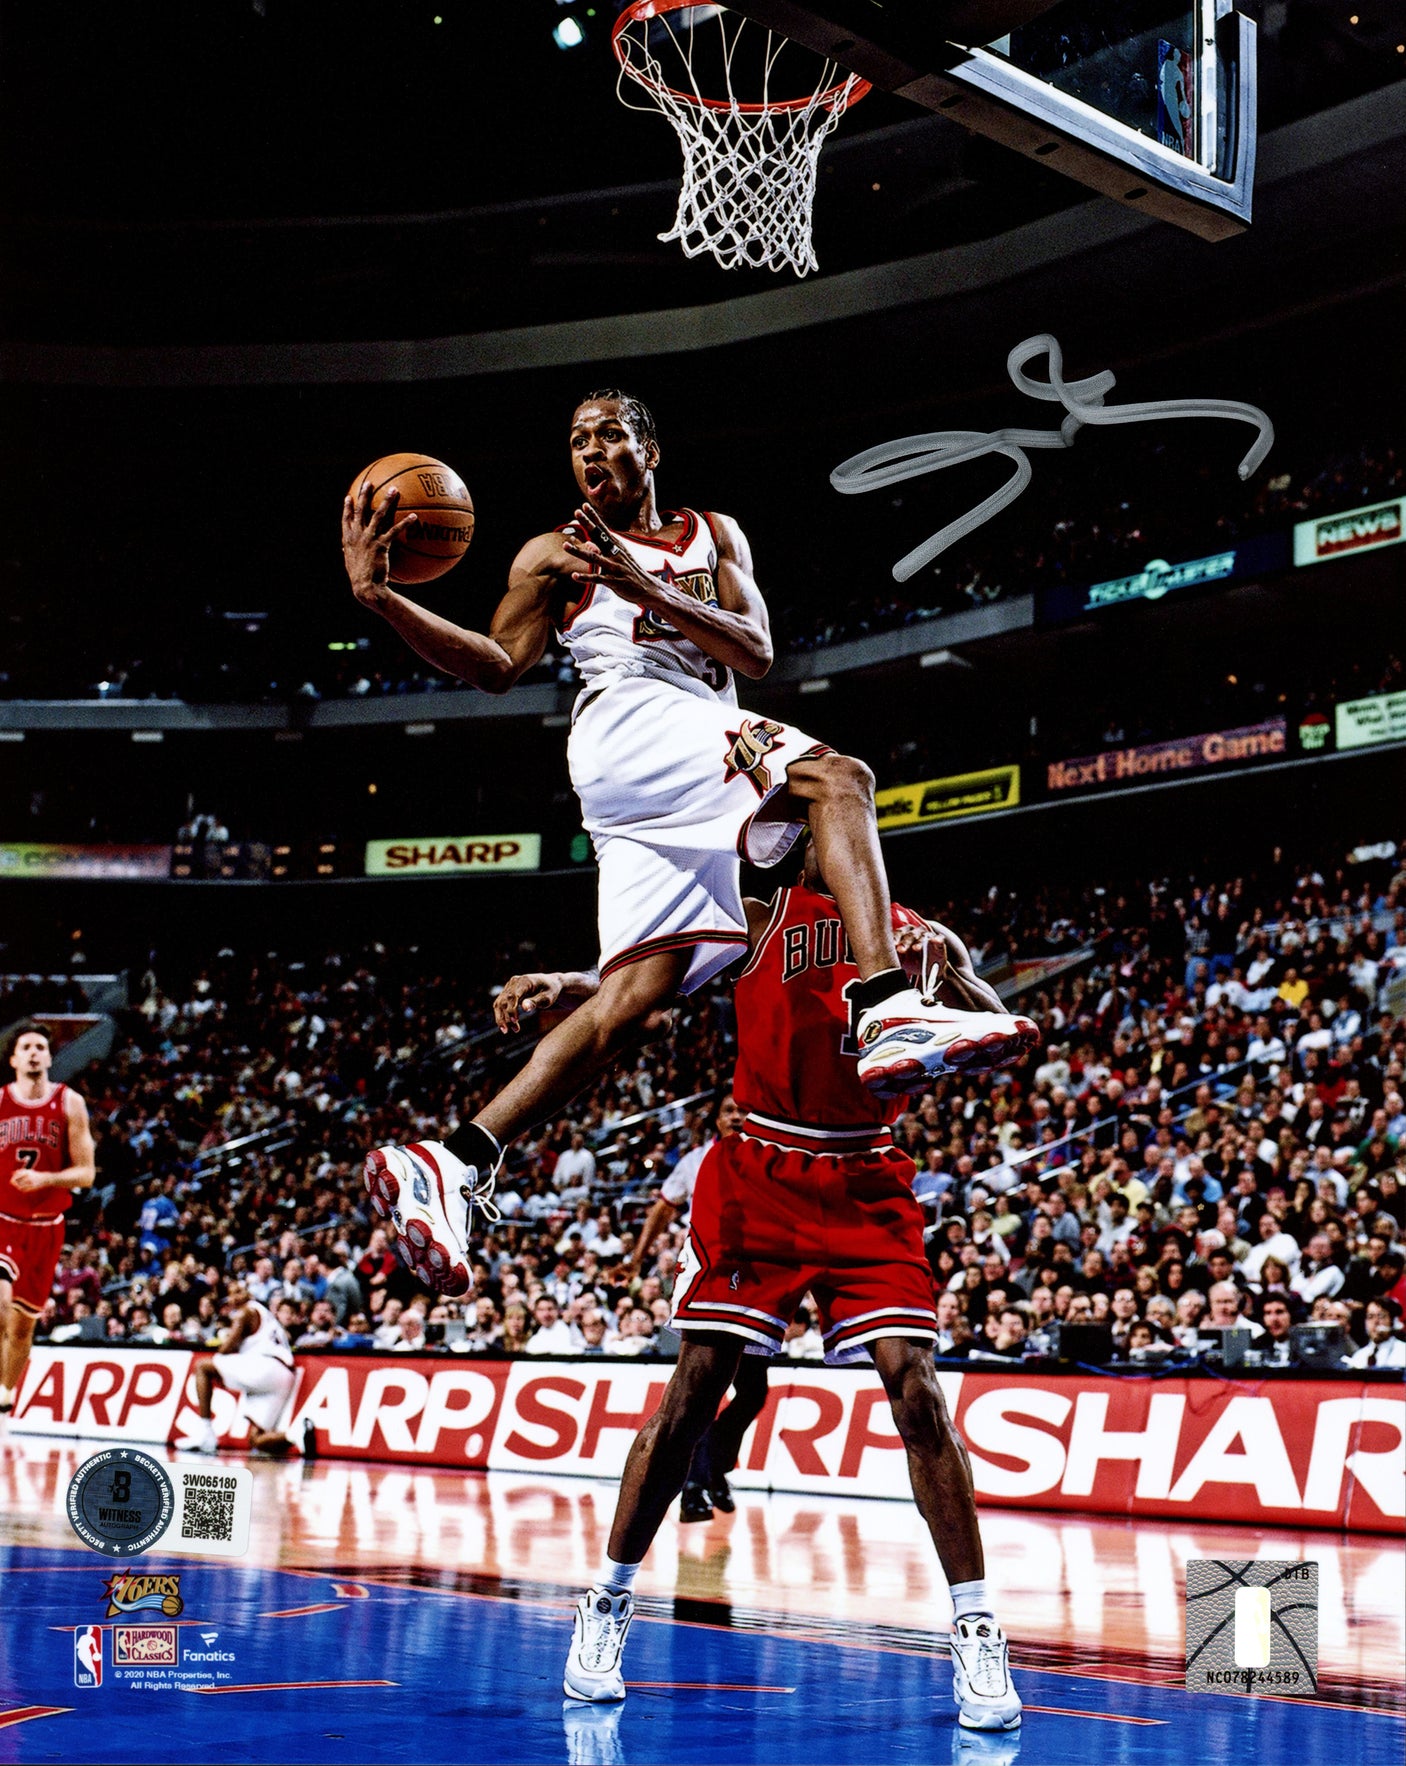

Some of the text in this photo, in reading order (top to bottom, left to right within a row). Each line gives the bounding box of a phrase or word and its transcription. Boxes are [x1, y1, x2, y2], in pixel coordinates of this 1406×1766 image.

[1319, 510, 1398, 547] NEWS
[1048, 754, 1107, 789] Next
[1114, 748, 1194, 778] Home
[1202, 731, 1286, 763] Game
[385, 841, 520, 869] SHARP
[16, 1147, 41, 1170] 7
[503, 1376, 905, 1478] SHRP
[183, 1474, 237, 1489] 3W065180
[69, 1452, 112, 1549] BECKETT VERIFIED AUTHENTIC
[99, 1508, 142, 1523] WITNESS
[127, 1454, 170, 1551] BECKETT VERIFIED AUTHENTIC
